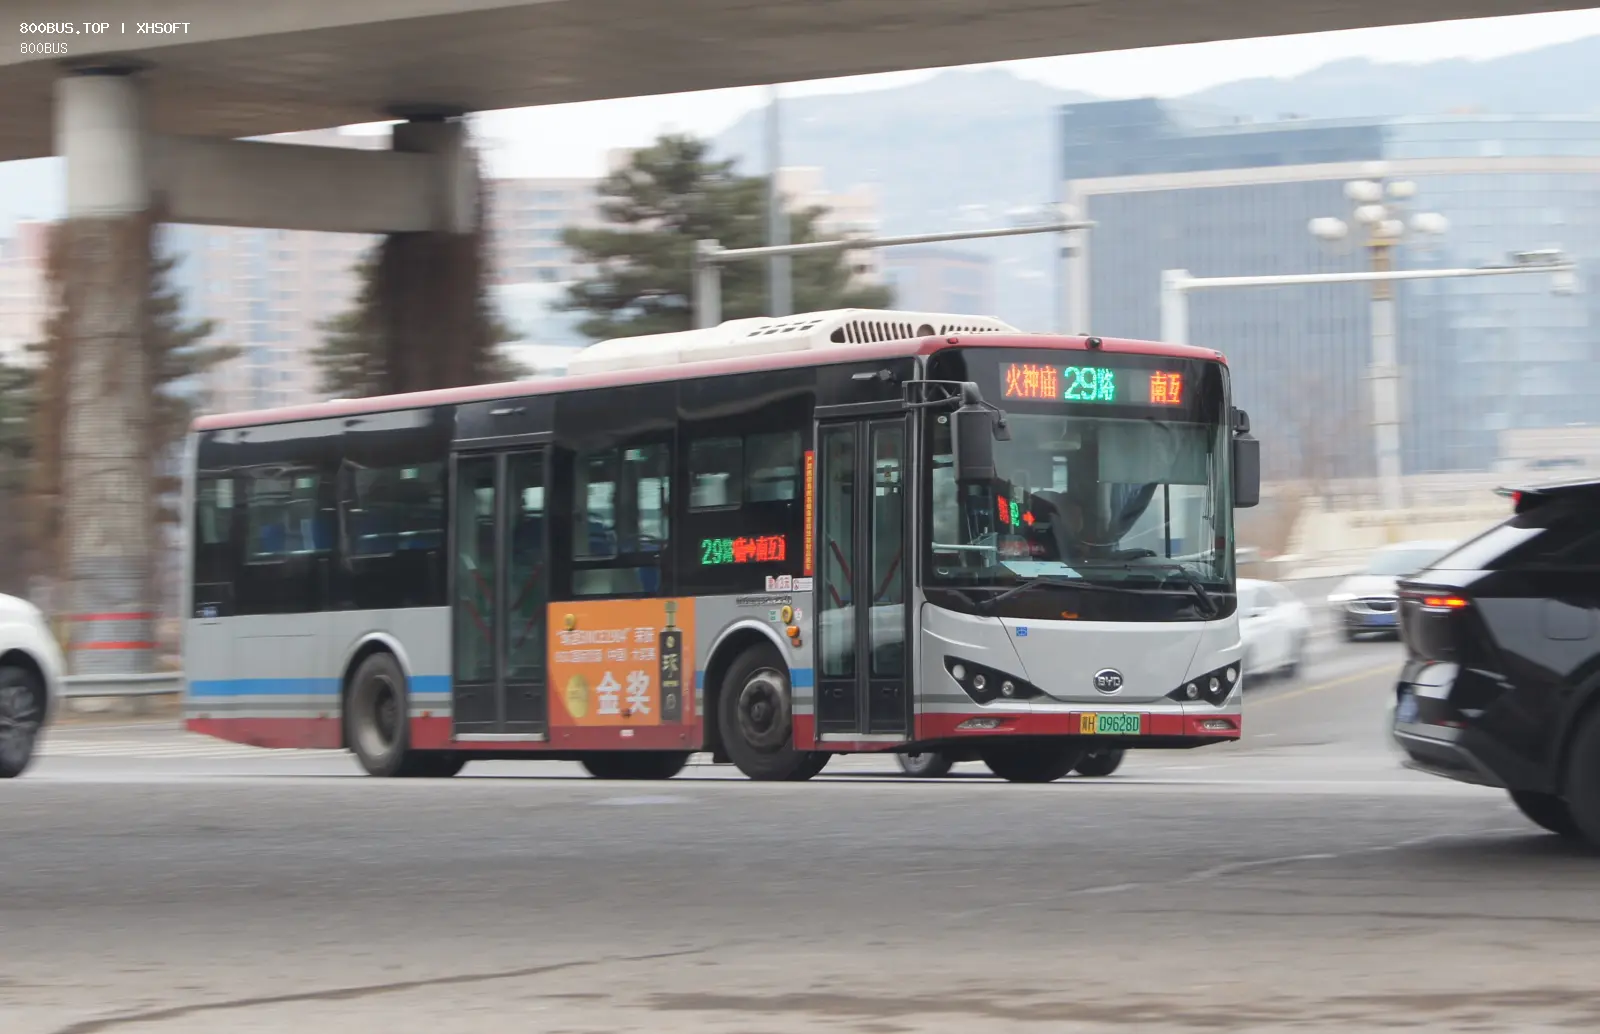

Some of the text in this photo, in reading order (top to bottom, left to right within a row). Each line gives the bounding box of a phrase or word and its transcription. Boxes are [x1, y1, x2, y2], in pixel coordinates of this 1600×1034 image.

[1004, 363, 1058, 399] 火神庙
[1063, 366, 1116, 401] 29路
[596, 669, 652, 716] 金奖
